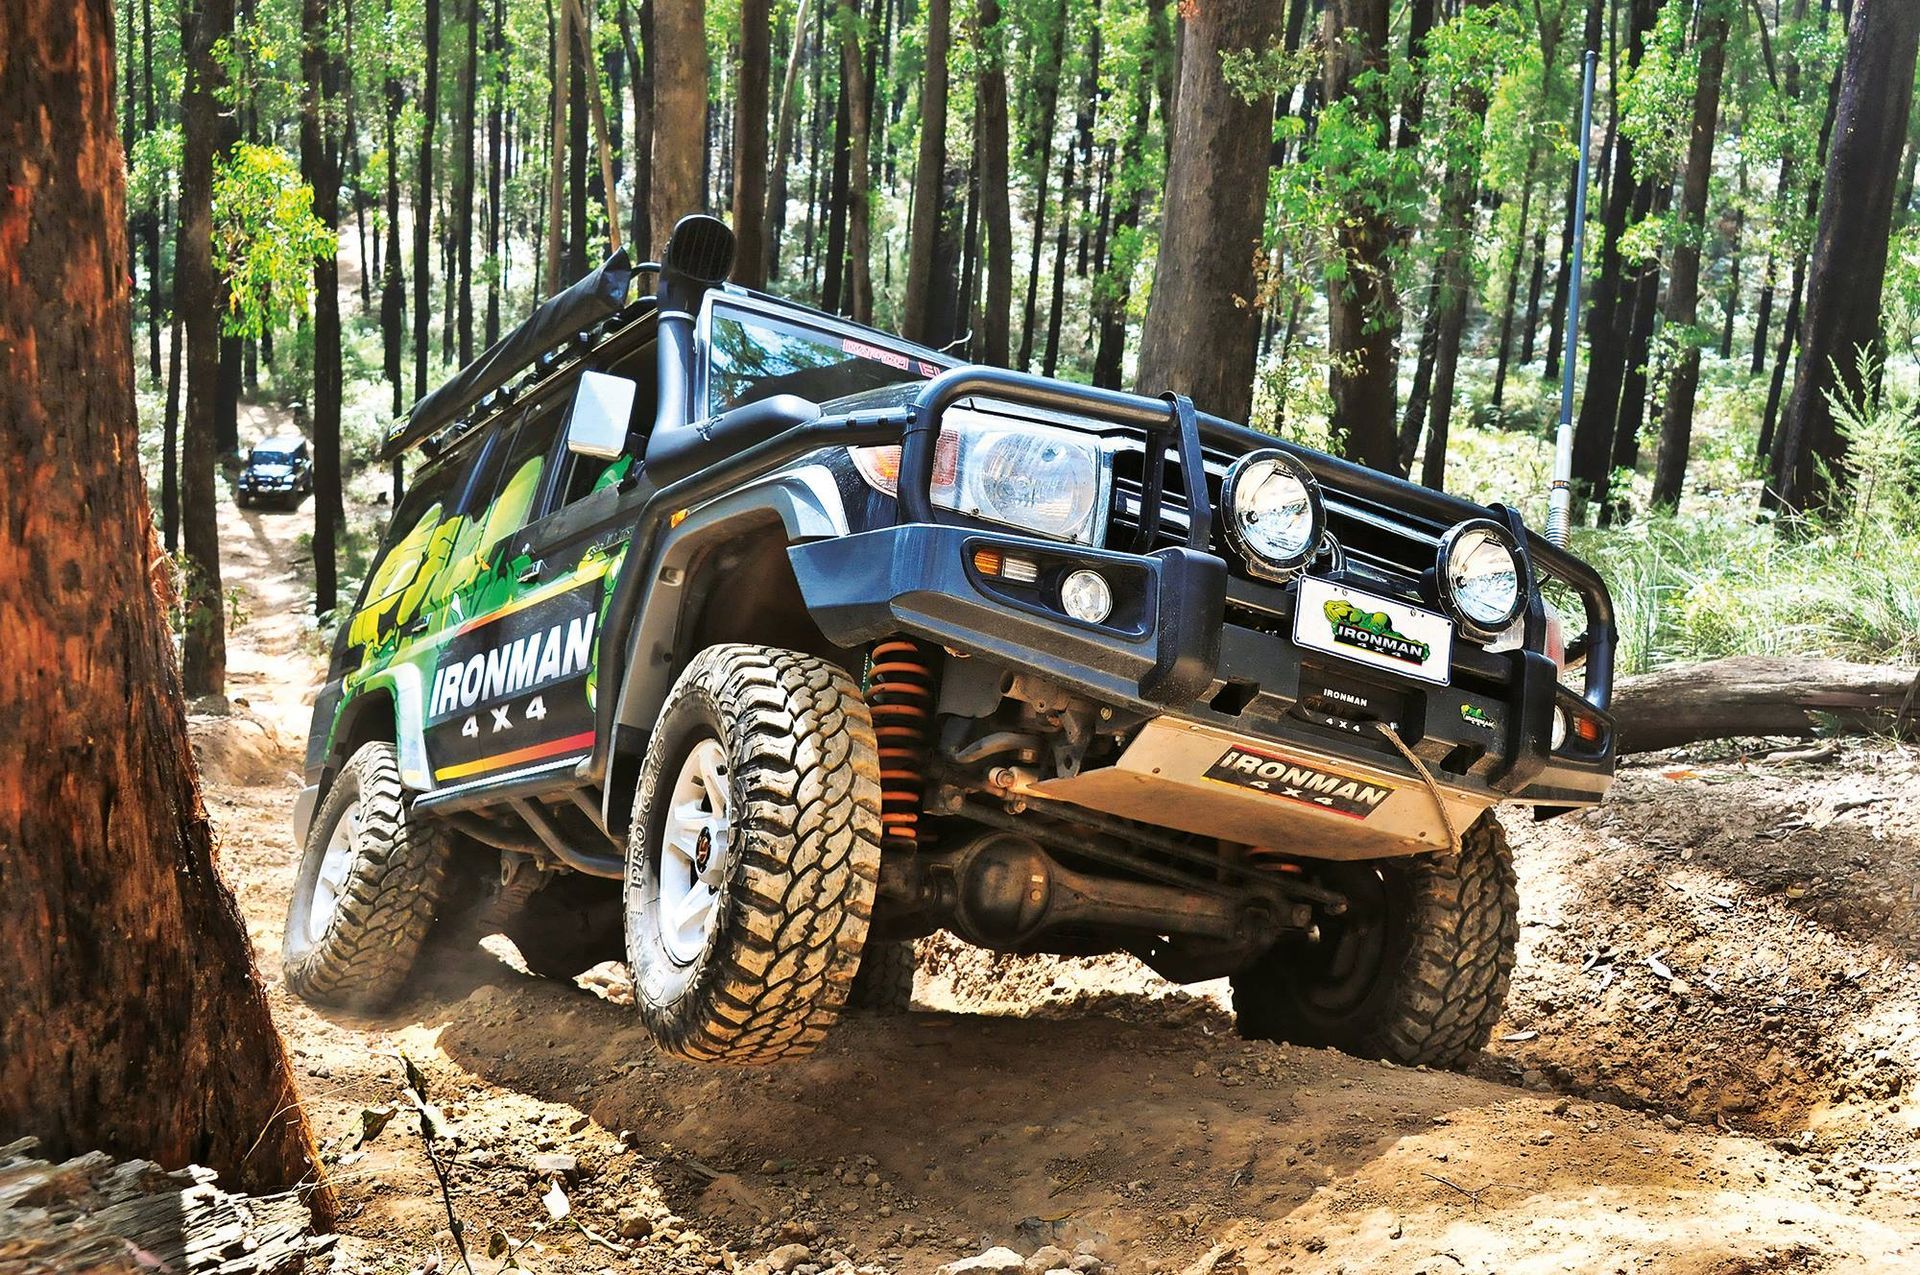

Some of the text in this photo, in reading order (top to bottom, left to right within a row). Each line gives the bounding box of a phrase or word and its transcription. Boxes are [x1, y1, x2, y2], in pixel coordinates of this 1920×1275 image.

[1338, 625, 1423, 657] IRONMAN
[429, 612, 597, 718] IRONMAN
[1323, 688, 1368, 707] IRONMAN
[1219, 751, 1387, 806] IRONMAN
